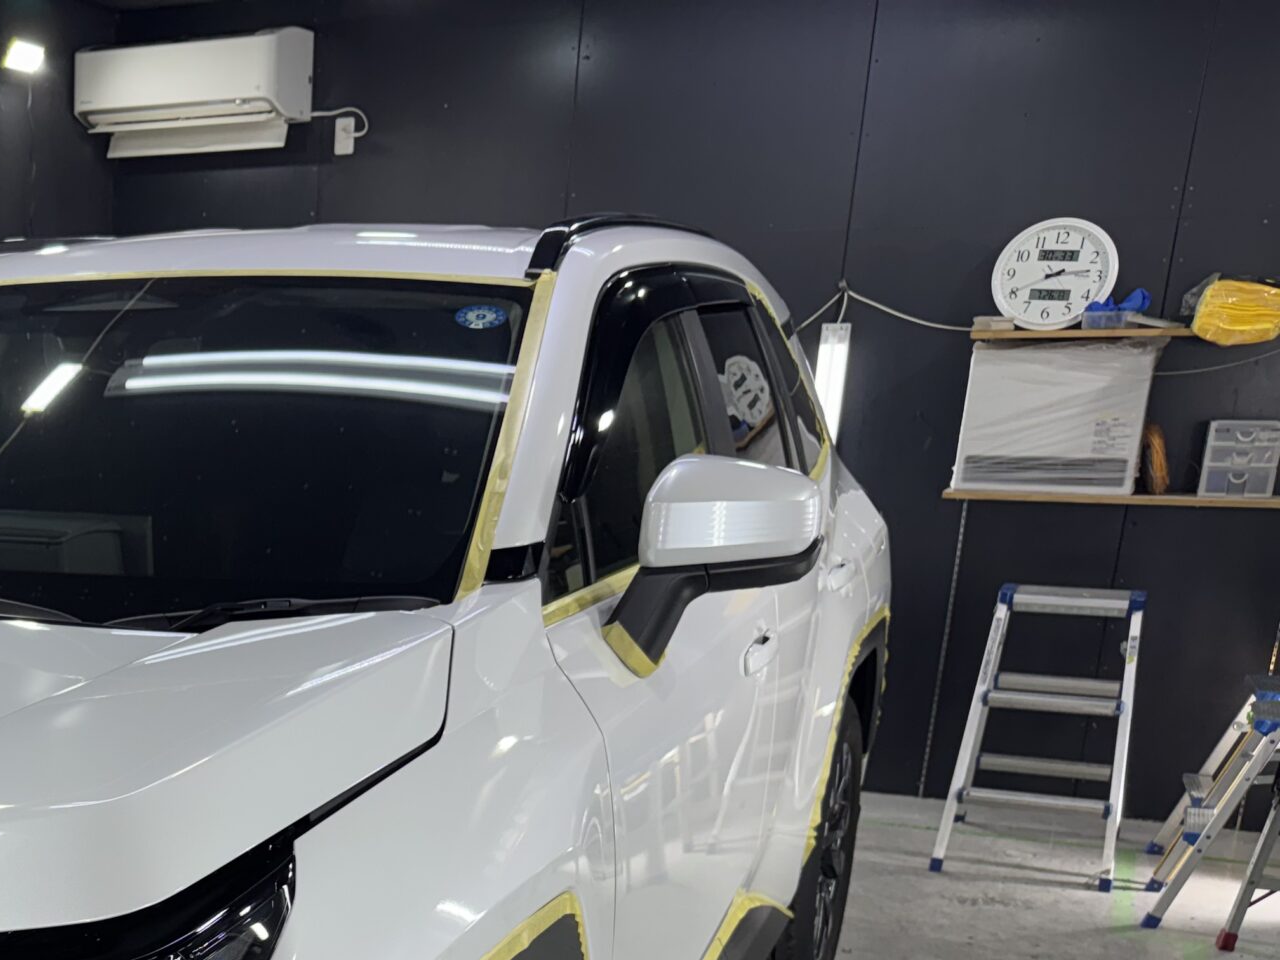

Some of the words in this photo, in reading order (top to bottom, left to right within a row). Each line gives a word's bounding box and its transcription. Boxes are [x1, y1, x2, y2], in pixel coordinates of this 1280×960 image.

[1035, 236, 1046, 249] 11
[1055, 231, 1070, 245] 12
[1080, 236, 1085, 250] 1
[1016, 249, 1031, 263] 10
[1089, 250, 1100, 264] 2
[1007, 267, 1016, 281] 9
[1092, 269, 1103, 284] 3
[1009, 286, 1019, 300] 8
[1080, 288, 1091, 302] 4
[1022, 300, 1032, 314] 7
[1040, 306, 1050, 320] 6
[1061, 302, 1073, 316] 5
